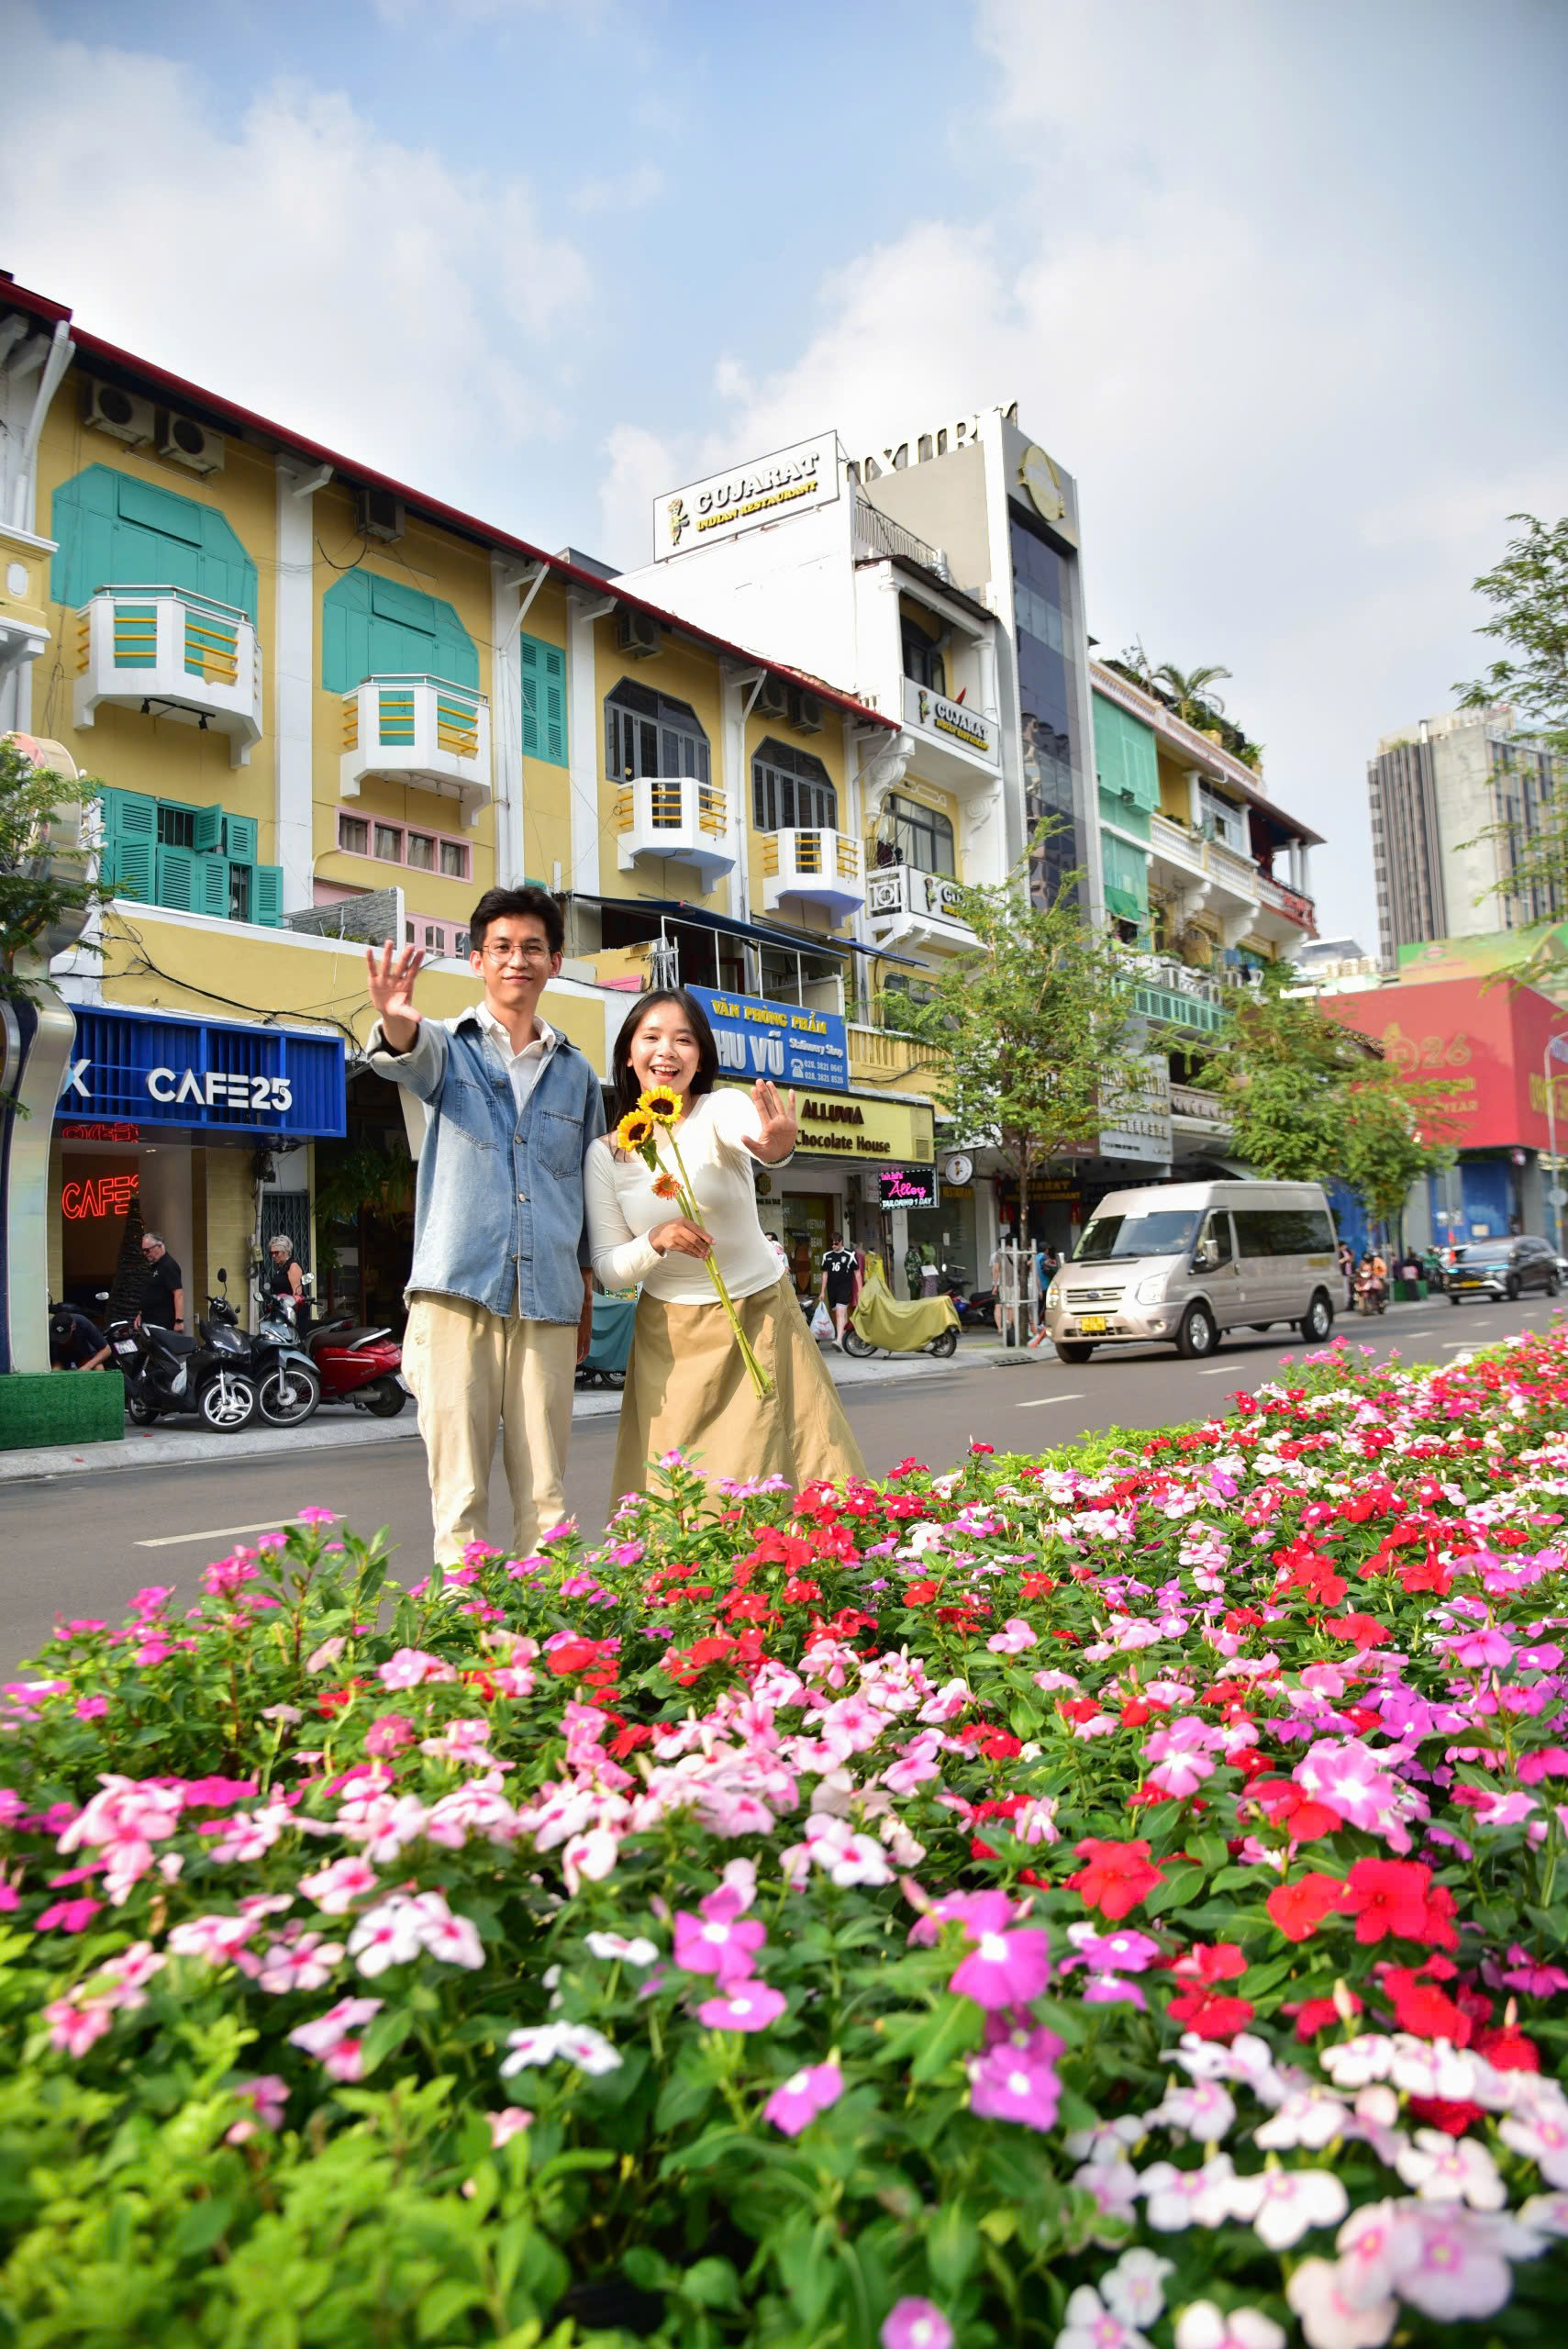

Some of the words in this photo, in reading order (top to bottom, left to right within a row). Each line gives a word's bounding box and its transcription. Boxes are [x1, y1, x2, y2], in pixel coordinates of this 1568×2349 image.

[694, 451, 819, 515] GUJARAT
[696, 508, 739, 532] INDIAN
[740, 480, 818, 517] RESTAURANT
[935, 702, 986, 740] GUJARAT
[711, 997, 740, 1019] VĂN
[743, 1005, 788, 1028] PHÒNG
[791, 1011, 828, 1035] PHẨM
[711, 1029, 746, 1070] HU
[749, 1030, 784, 1075] VŨ
[789, 1038, 825, 1055] Stationery
[825, 1043, 844, 1058] Shop
[146, 1067, 293, 1111] CAFE25
[800, 1098, 864, 1125] ALLUVIA
[795, 1130, 853, 1150] Chocolate
[856, 1136, 891, 1153] House
[918, 1197, 932, 1205] DAY
[831, 1262, 841, 1272] 16
